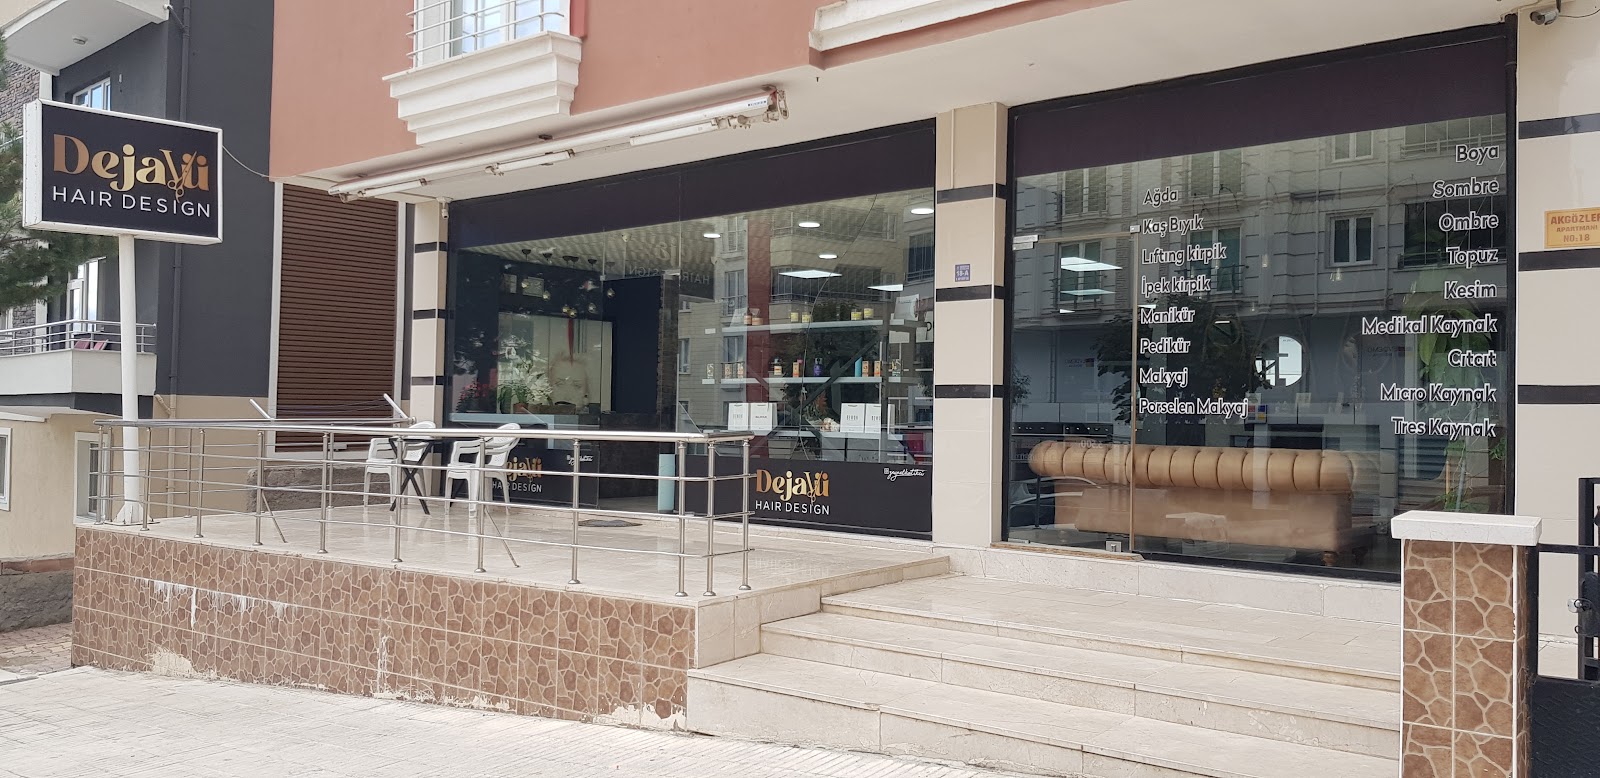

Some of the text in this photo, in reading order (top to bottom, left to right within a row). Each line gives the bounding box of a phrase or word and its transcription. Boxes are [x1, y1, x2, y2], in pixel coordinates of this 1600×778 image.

[1455, 144, 1500, 166] Boya
[1143, 186, 1179, 208] Ağda
[1432, 176, 1500, 199] Sombre
[52, 185, 211, 218] HAIR DESIGN
[1142, 218, 1167, 238] Kaş
[1438, 210, 1499, 232] Ombre
[1556, 225, 1598, 233] APARTMANI
[1186, 242, 1227, 265] kirpik
[1446, 246, 1499, 269] Topuz
[1141, 274, 1211, 298] İpek kirpik
[1444, 279, 1497, 299] Kesim
[1140, 306, 1195, 325] Manikür
[1362, 313, 1498, 338] Medikal Kaynak
[1140, 337, 1190, 354] Pedikür
[1139, 367, 1188, 387] Makyaj
[1429, 383, 1497, 406] Kaynak
[1139, 398, 1249, 419] Porselen Makyaj
[1391, 416, 1497, 441] Tres Kaynak
[511, 482, 542, 493] DESIGN
[755, 500, 830, 515] HAIR DESIGN
